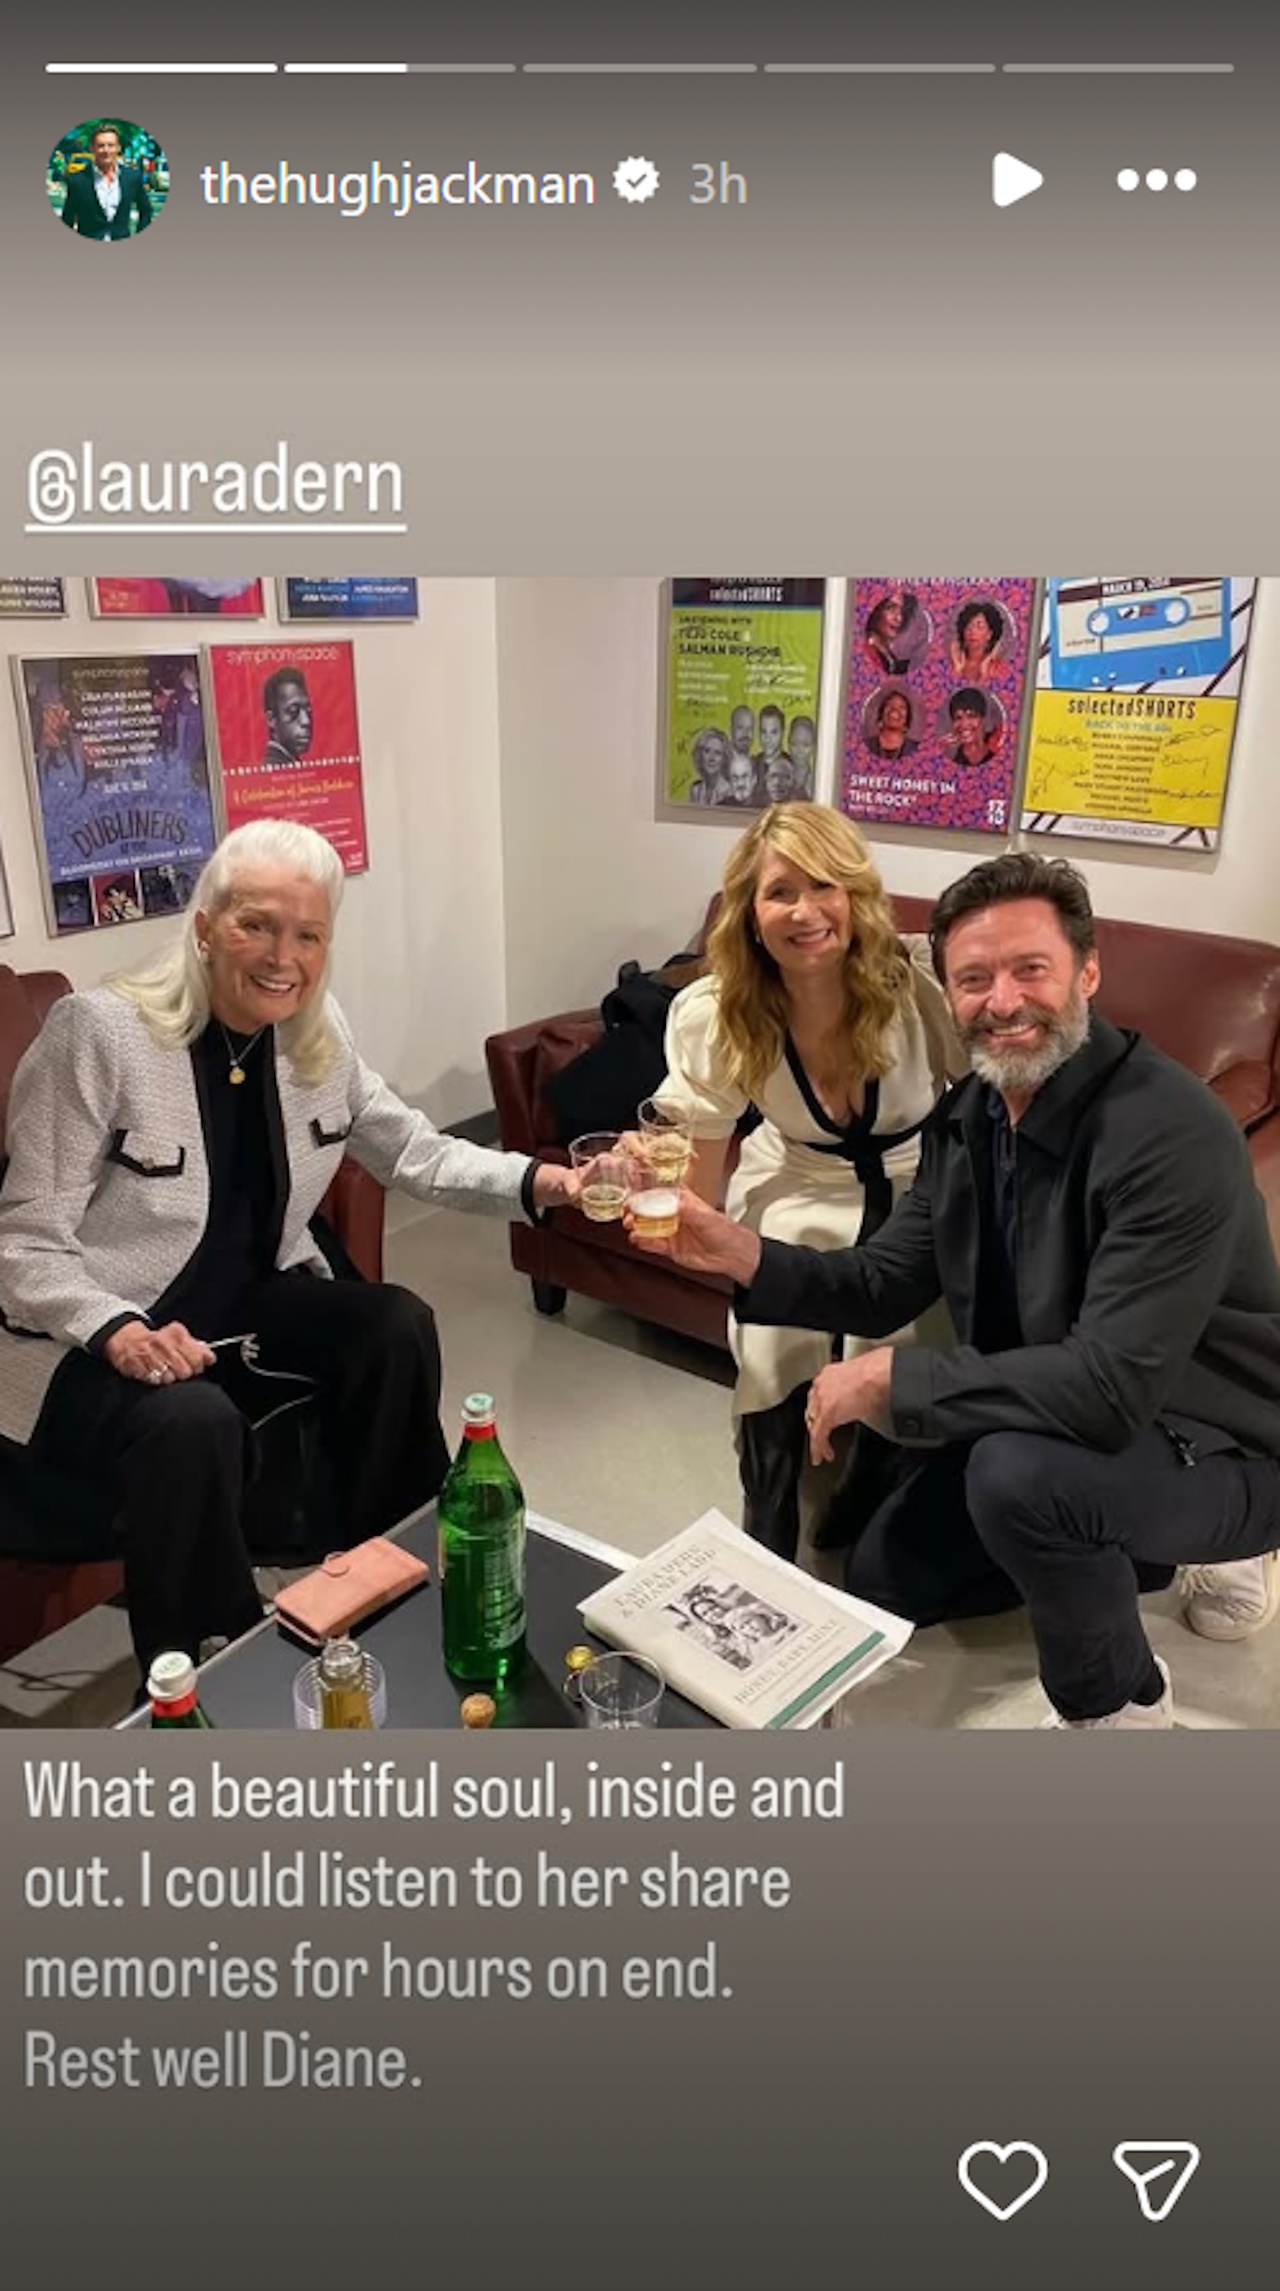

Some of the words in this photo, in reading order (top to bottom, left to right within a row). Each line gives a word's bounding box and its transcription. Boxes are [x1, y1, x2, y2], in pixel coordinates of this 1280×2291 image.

[711, 629, 740, 642] COLE
[679, 644, 726, 656] SALMAN
[1067, 697, 1196, 720] selectedSHORTS
[850, 774, 889, 789] SWEET
[892, 777, 939, 792] HONEY
[940, 782, 956, 794] IN
[849, 790, 873, 804] THE
[70, 808, 188, 858] DUBLINERS
